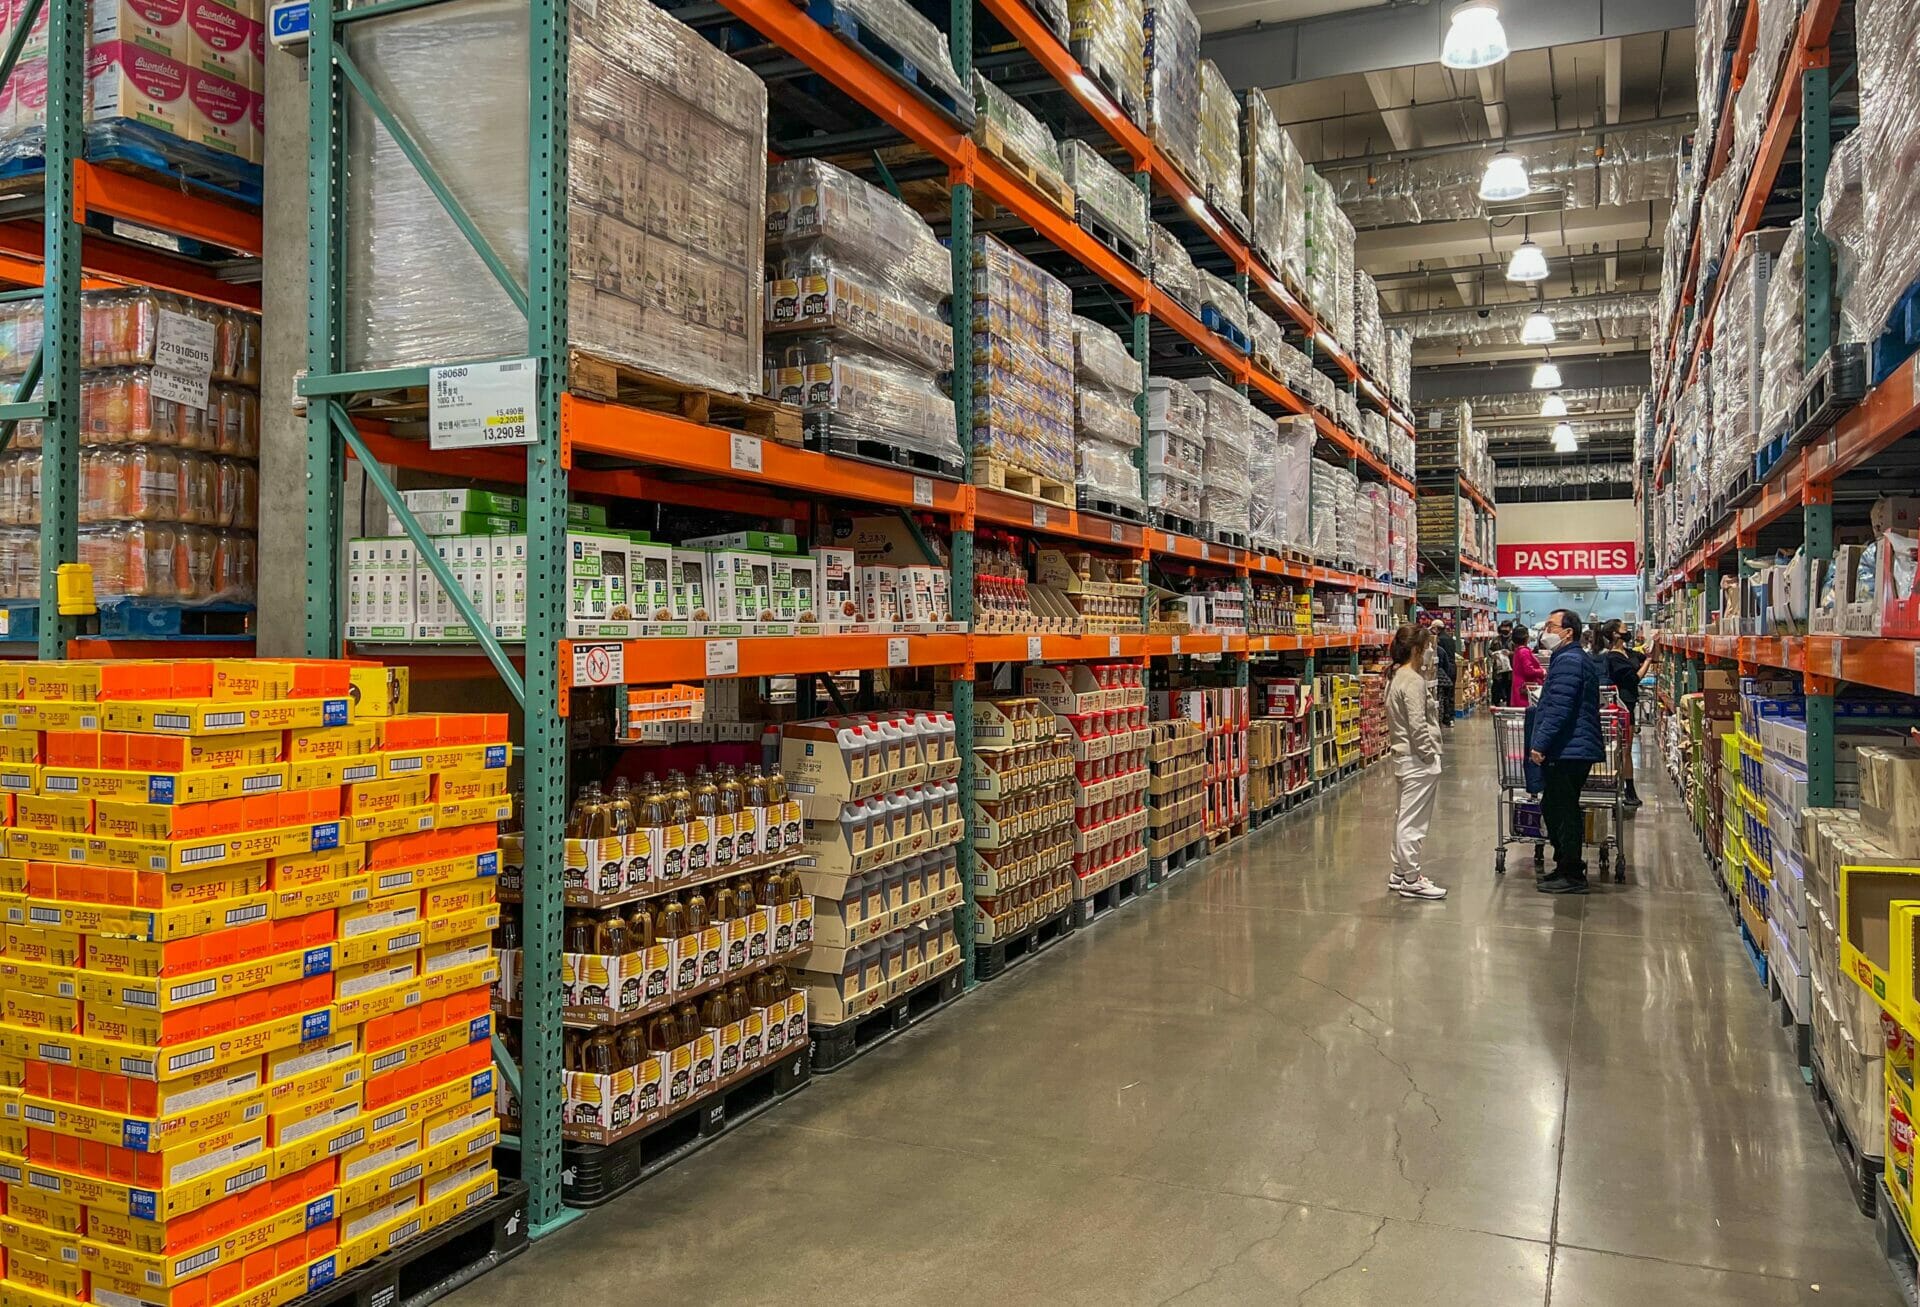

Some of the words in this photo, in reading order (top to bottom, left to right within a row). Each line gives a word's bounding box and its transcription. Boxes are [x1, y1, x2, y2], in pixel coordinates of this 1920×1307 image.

[160, 341, 209, 361] 2219105015
[437, 368, 468, 379] 580680
[483, 425, 525, 440] 13,290원
[1515, 549, 1627, 570] PASTRIES
[717, 847, 732, 860] 미림
[738, 841, 752, 854] 미림
[666, 861, 681, 873] 미림
[690, 855, 705, 869] 미림
[602, 872, 619, 888] 미림
[629, 867, 646, 882] 미림
[751, 945, 765, 956] 미림
[729, 952, 744, 964] 미림
[703, 962, 718, 974] 미림
[680, 971, 695, 983] 미림
[648, 982, 664, 995] 미림
[623, 990, 638, 1003] 미림
[745, 1046, 759, 1059] 미림
[722, 1057, 736, 1069] 미림
[696, 1072, 710, 1084] 미림
[672, 1084, 688, 1097] 미림
[641, 1095, 656, 1110] 미림
[613, 1106, 630, 1122] 미림
